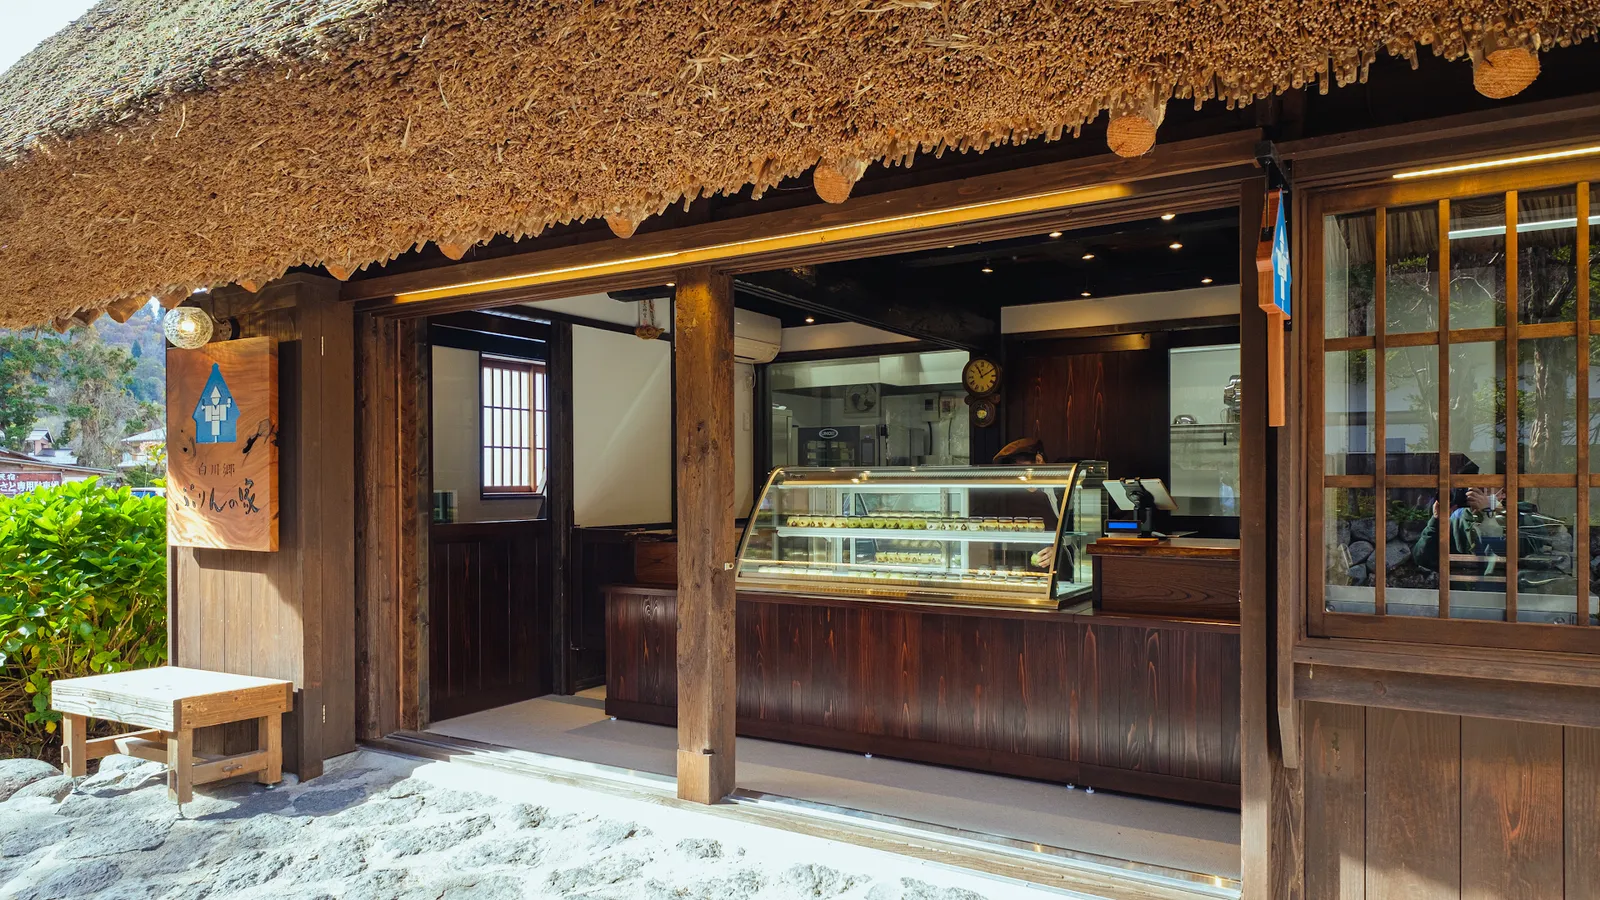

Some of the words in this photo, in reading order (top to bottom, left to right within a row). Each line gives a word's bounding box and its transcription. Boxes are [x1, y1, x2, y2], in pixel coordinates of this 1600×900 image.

[199, 462, 235, 477] 白川郷
[175, 478, 260, 515] ぷりんの家
